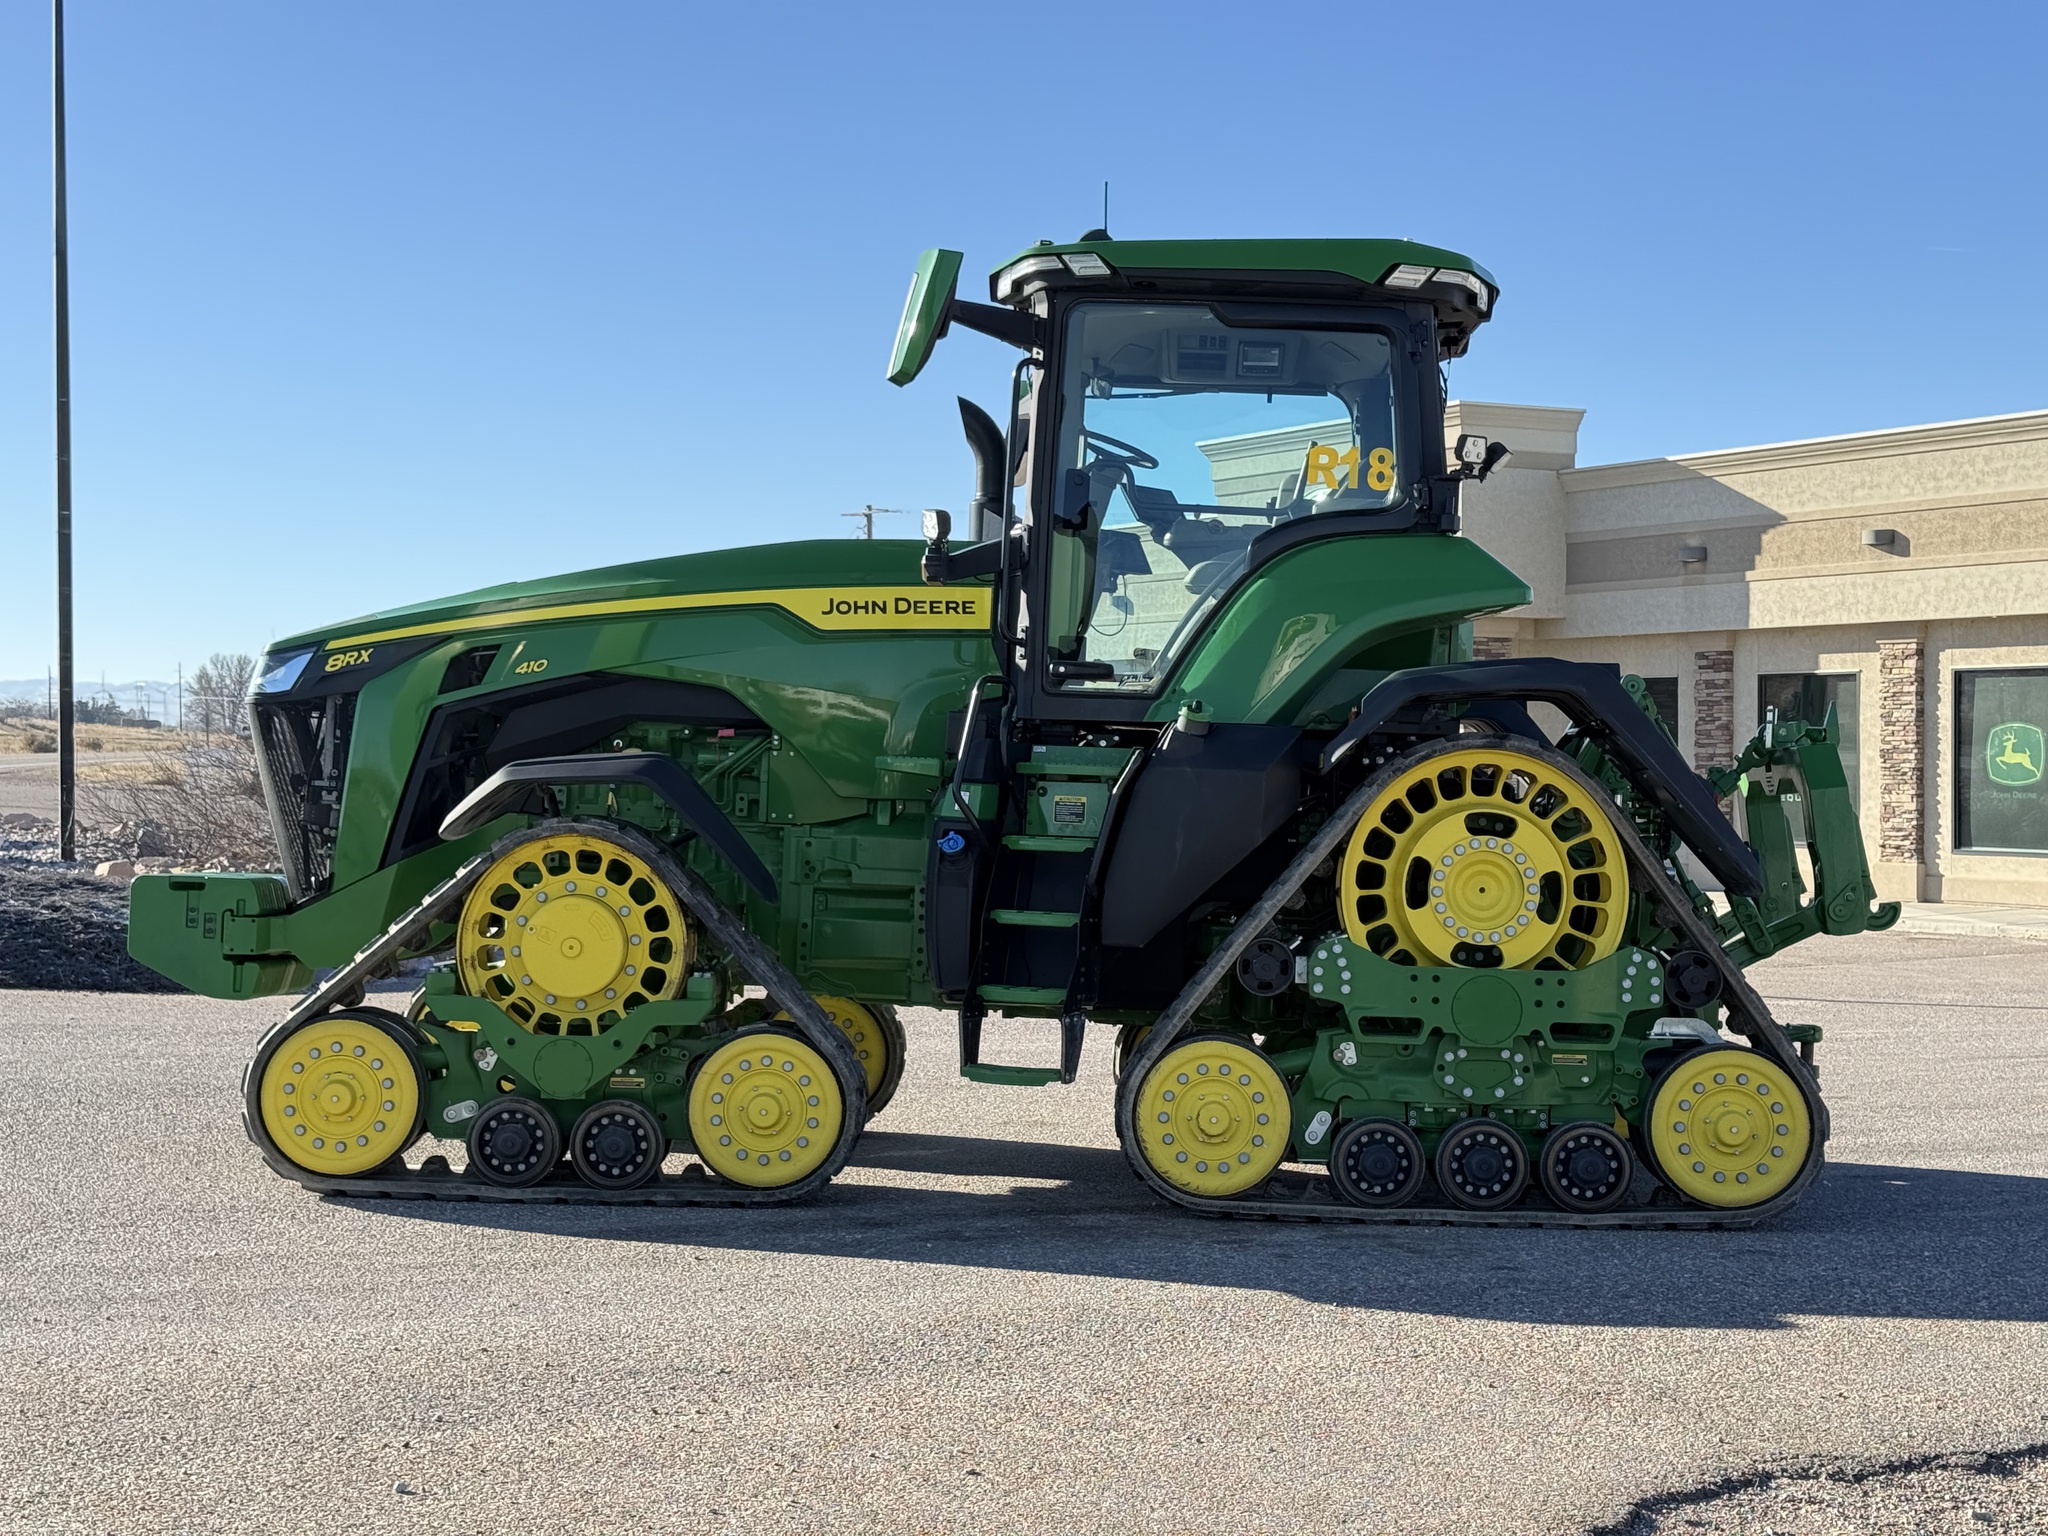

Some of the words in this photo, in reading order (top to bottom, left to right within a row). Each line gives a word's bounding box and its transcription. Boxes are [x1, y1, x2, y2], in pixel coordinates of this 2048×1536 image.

[1308, 445, 1394, 491] R18
[821, 597, 887, 615] JOHN
[894, 597, 976, 615] DEERE
[324, 648, 375, 672] 8RX
[514, 659, 549, 674] 410
[1990, 790, 2011, 799] JOHN
[2012, 790, 2038, 799] DEERE
